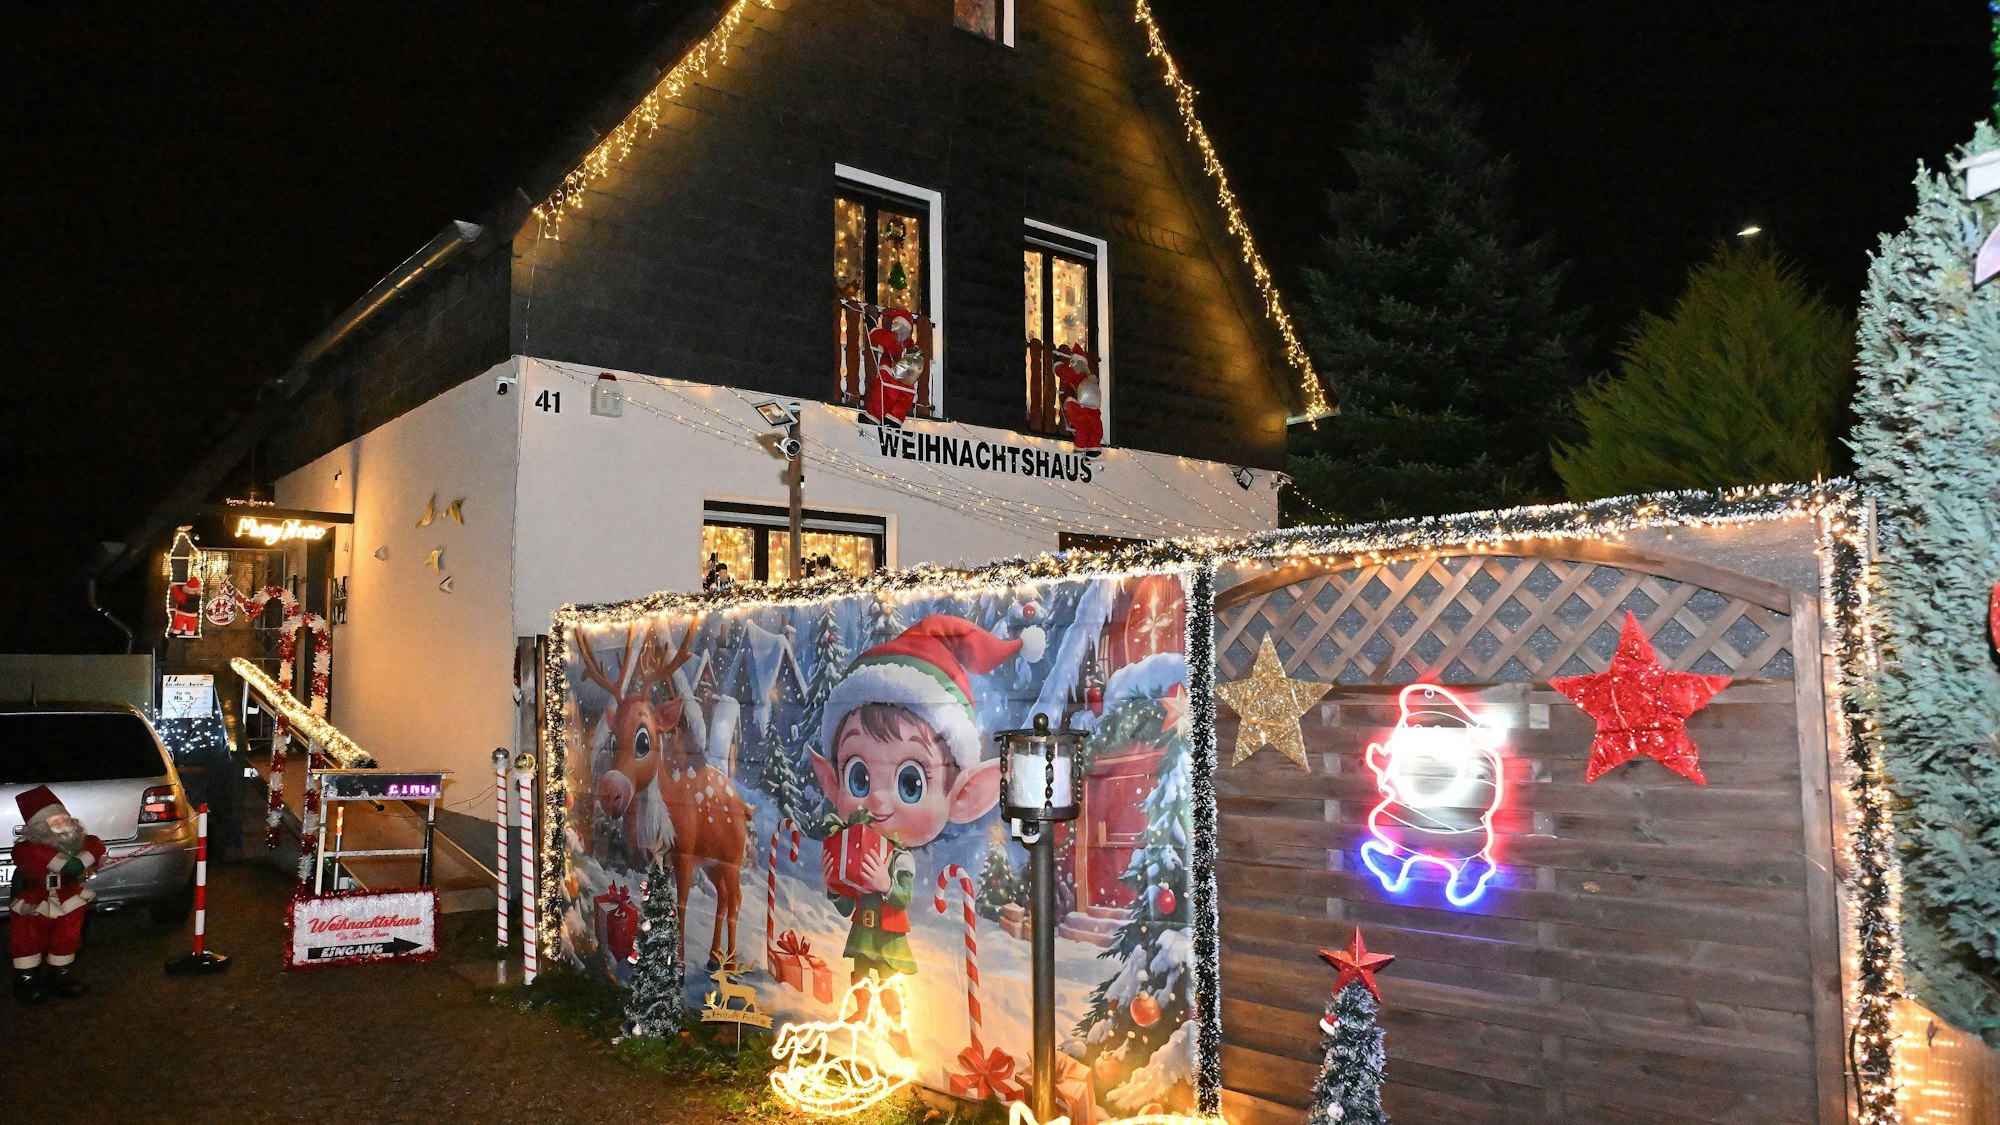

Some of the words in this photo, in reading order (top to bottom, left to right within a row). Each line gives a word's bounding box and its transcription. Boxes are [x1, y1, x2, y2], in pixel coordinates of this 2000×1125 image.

[535, 390, 560, 413] 41
[878, 426, 1092, 483] WEIHNACHTSHAUS
[308, 914, 422, 934] Weihnachtshaus
